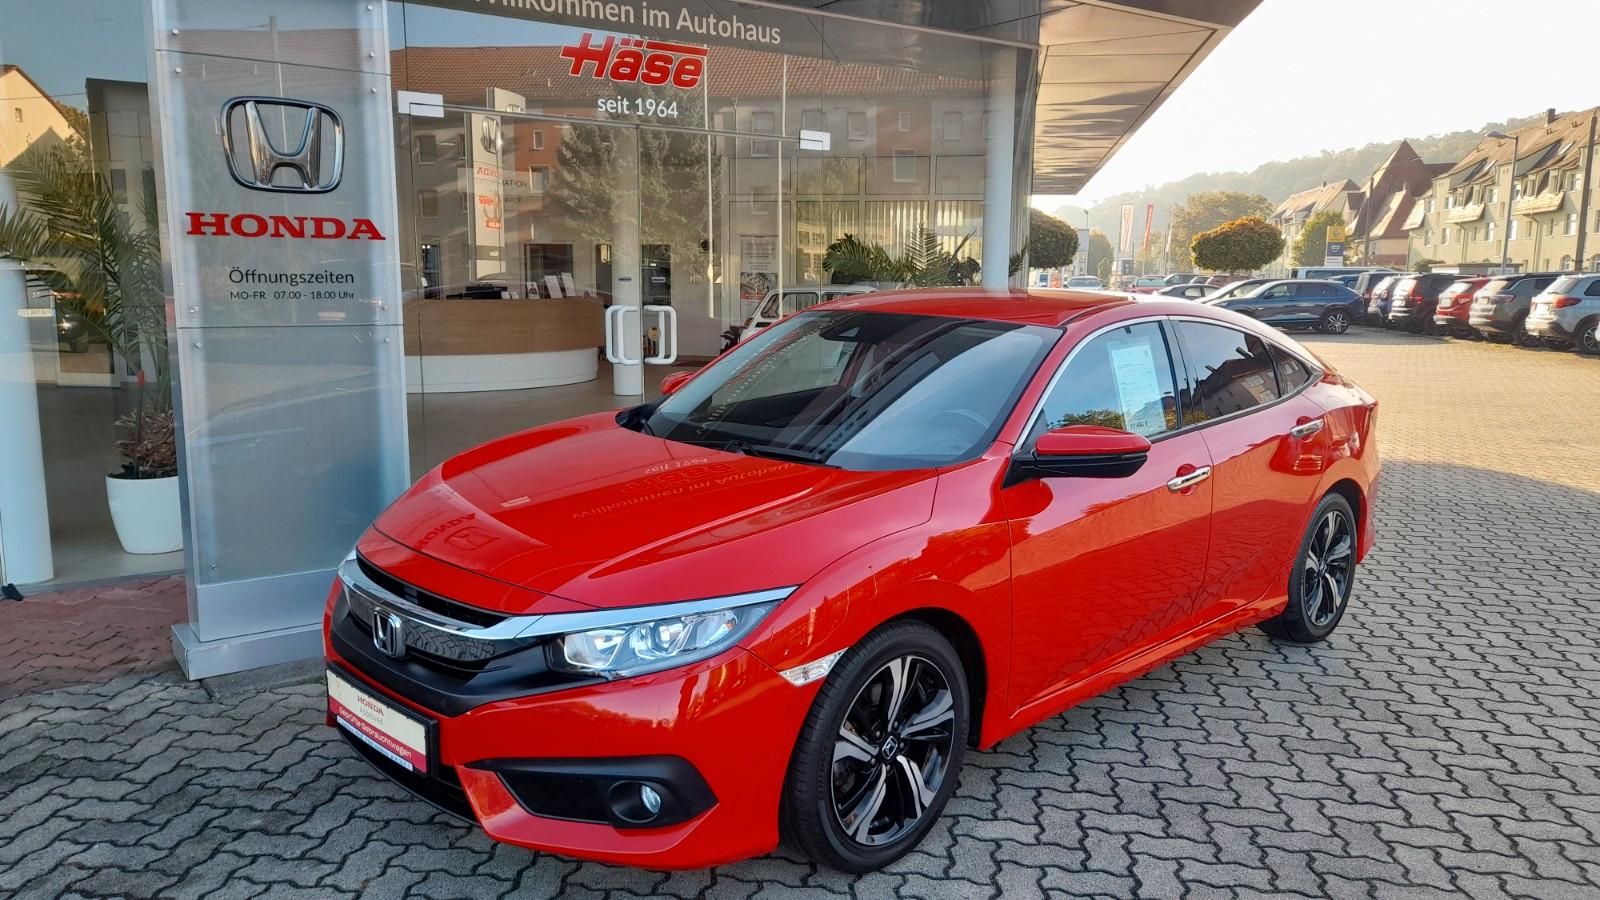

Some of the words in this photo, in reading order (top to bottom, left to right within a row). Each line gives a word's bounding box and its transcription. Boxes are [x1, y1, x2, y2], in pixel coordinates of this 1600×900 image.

[475, 0, 635, 24] ommen
[642, 1, 670, 29] im
[675, 7, 781, 44] Autohaus
[560, 32, 709, 89] Häse
[597, 96, 630, 114] seit
[635, 98, 679, 118] 1964
[185, 212, 386, 240] HONDA
[229, 266, 355, 286] Öffnungszeiten
[230, 291, 266, 299] MO-FR
[311, 290, 336, 299] 18.00
[338, 291, 355, 299] Uhr
[357, 695, 385, 717] HONDA
